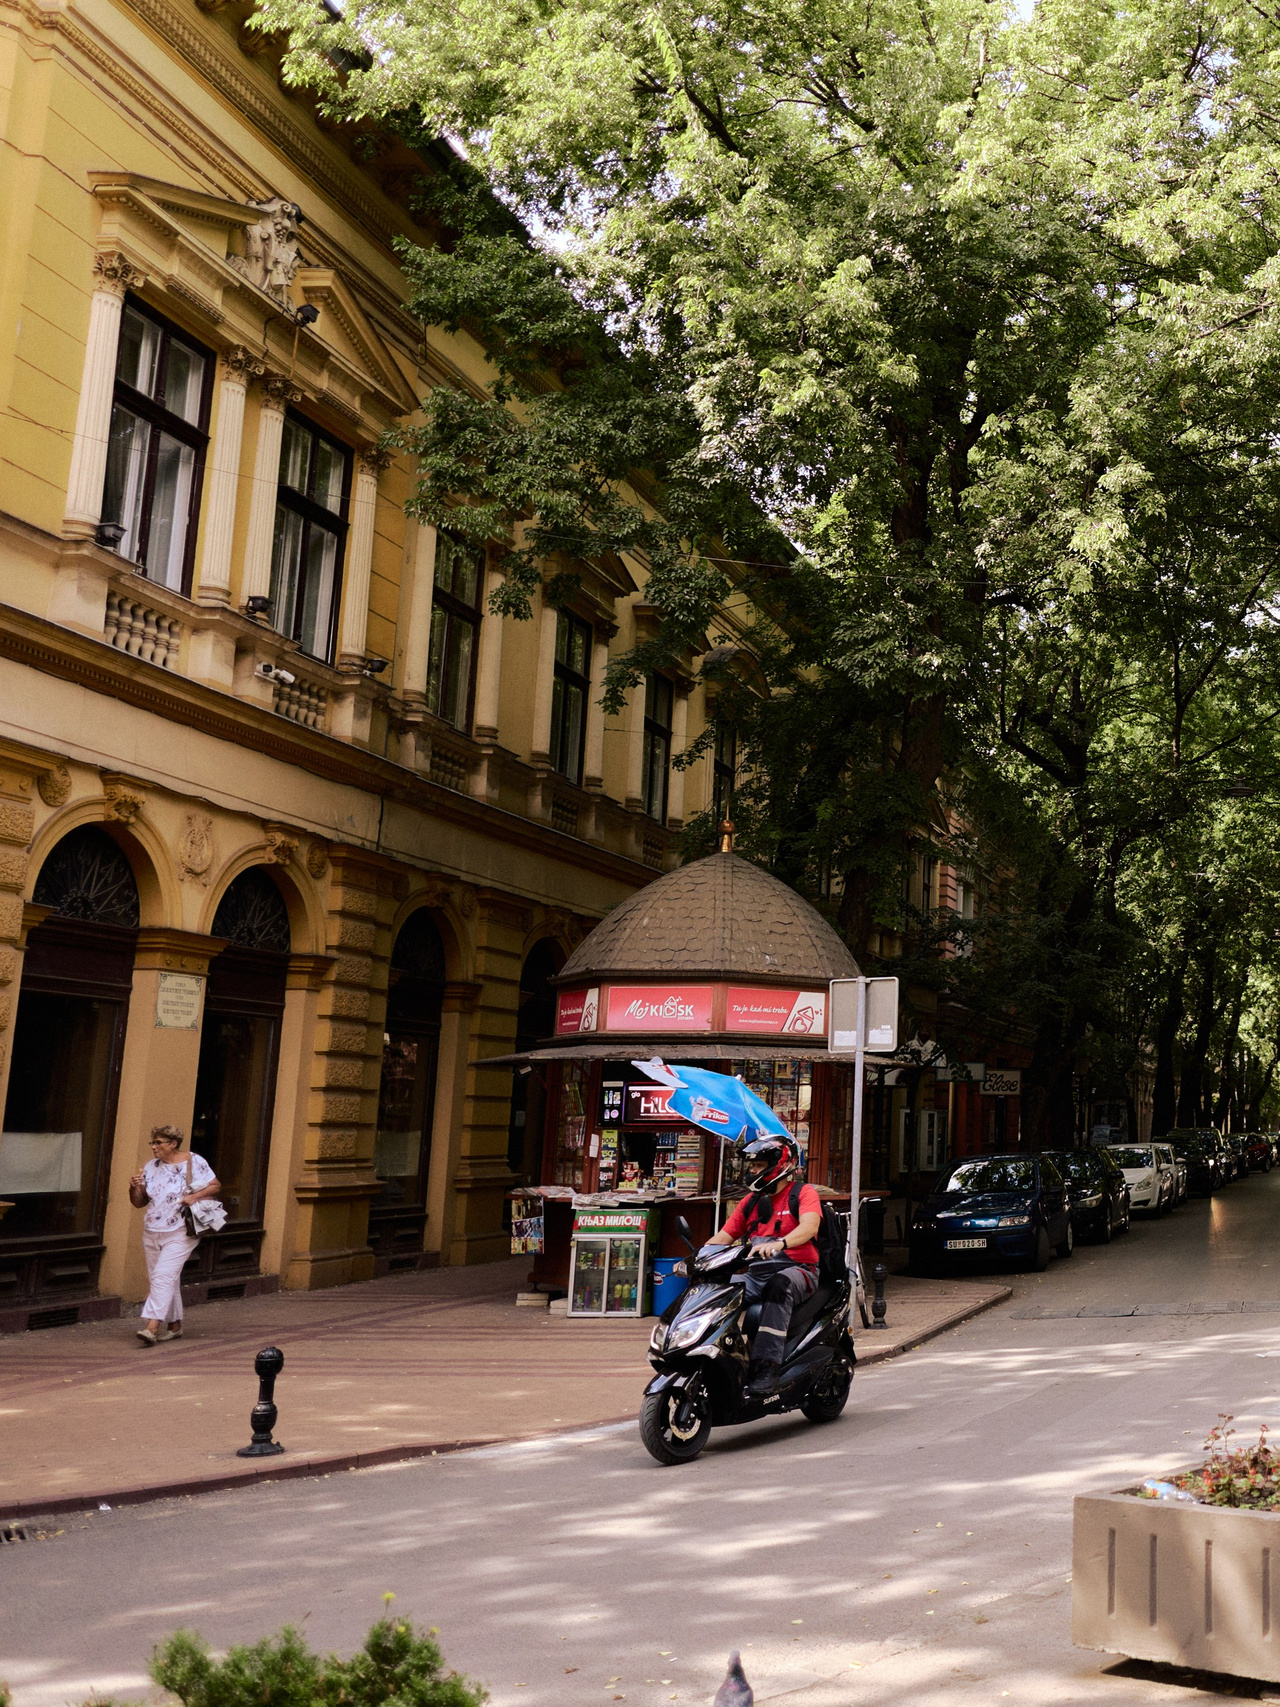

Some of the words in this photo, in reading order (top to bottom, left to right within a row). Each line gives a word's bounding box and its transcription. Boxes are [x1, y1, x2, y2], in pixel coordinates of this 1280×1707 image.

[625, 999, 650, 1019] Moj
[983, 1072, 1019, 1092] Elise
[578, 1215, 605, 1226] КЊАЗ
[605, 1215, 642, 1226] МИЛОШ
